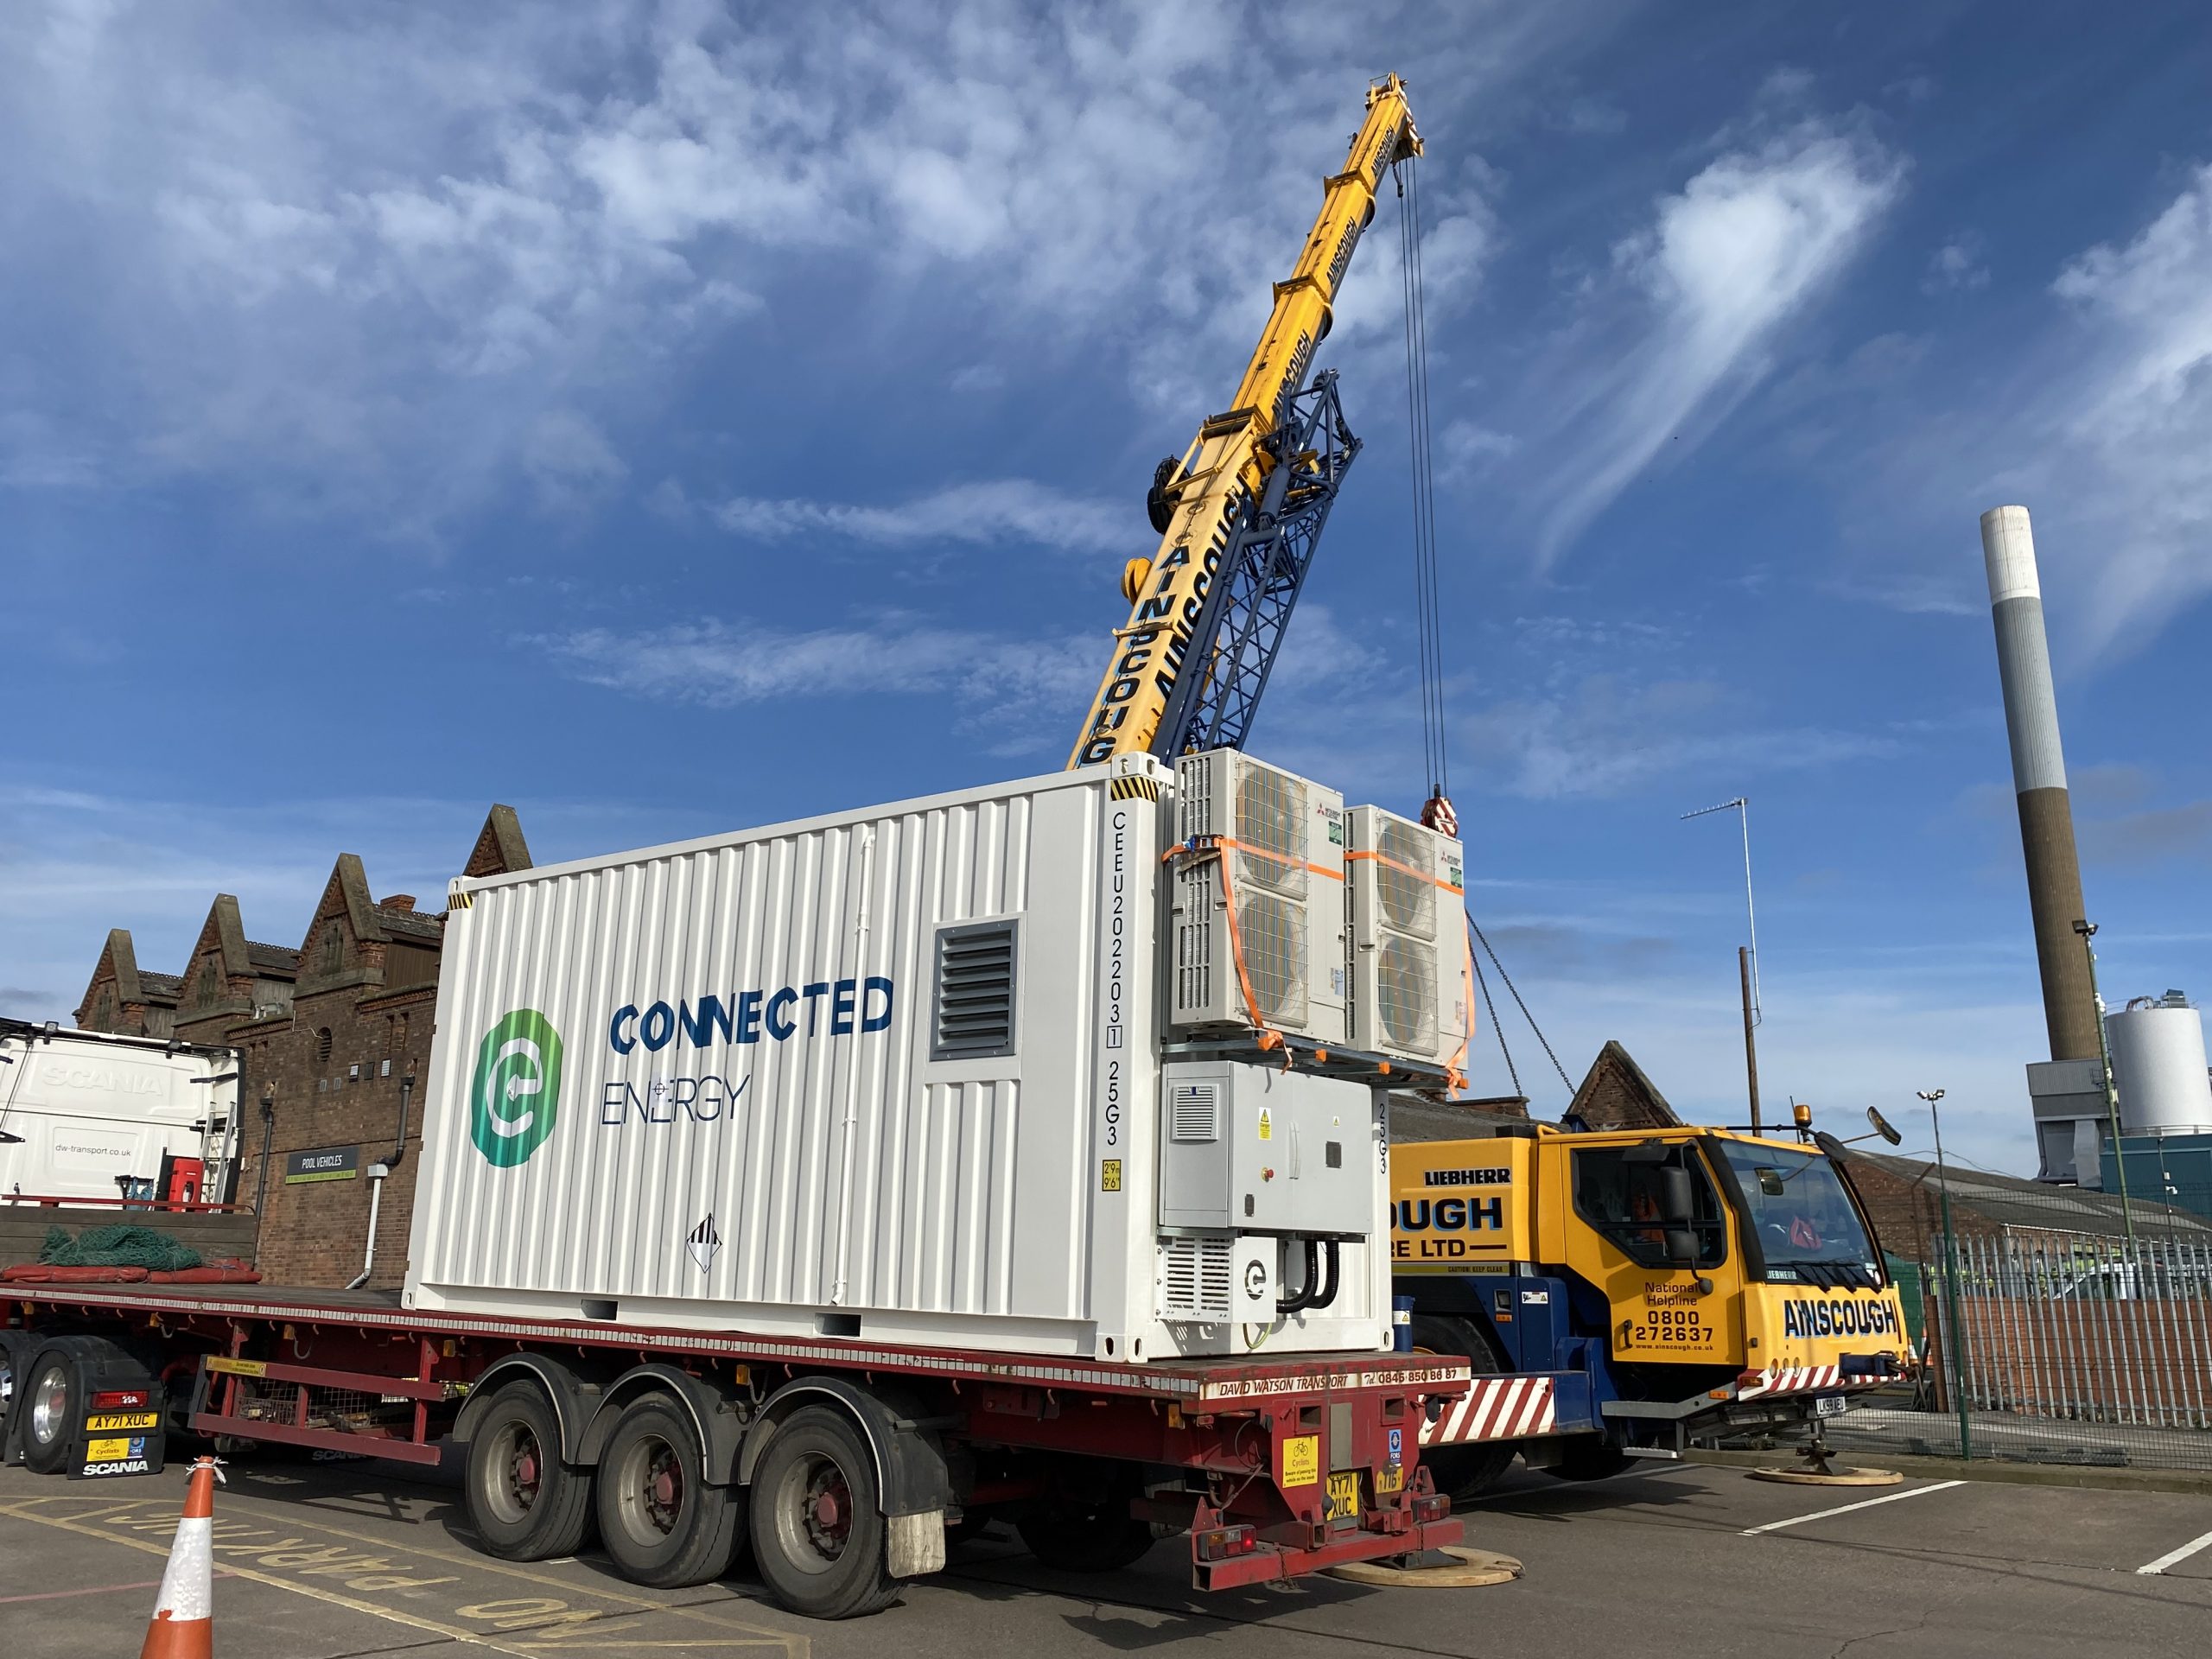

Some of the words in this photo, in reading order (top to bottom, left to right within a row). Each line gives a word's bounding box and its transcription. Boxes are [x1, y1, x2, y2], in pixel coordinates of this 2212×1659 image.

[1371, 124, 1395, 181] AINSCOUGH
[1326, 215, 1358, 291] AINSCOUGH
[610, 976, 893, 1056] CONNECTED
[43, 1066, 164, 1096] SCANIA
[601, 1074, 751, 1125] ENERGY
[1105, 1060, 1121, 1147] 25G3
[55, 1144, 131, 1157] dw-transport.co.uk
[302, 1158, 316, 1169] POOL
[316, 1154, 343, 1168] VEHICLES
[1424, 1168, 1511, 1186] LIEBHERR
[1390, 1197, 1503, 1231] UGH
[1421, 1239, 1466, 1257] LTD
[1644, 1282, 1699, 1294] National
[1647, 1294, 1697, 1308] Helpline
[1648, 1310, 1700, 1325] 0800
[1783, 1299, 1897, 1338] AINSCOUGH
[1636, 1326, 1713, 1342] 272637
[1219, 1382, 1250, 1396] DAVID
[1254, 1378, 1294, 1394] WATSON
[1296, 1375, 1349, 1390] TRANSPORT
[1408, 1370, 1427, 1382] 850
[1446, 1368, 1457, 1379] 87
[95, 1415, 123, 1428] AY71
[124, 1414, 150, 1427] XUC
[82, 1460, 149, 1476] SCANIA
[1292, 1459, 1310, 1468] Cyclists
[1331, 1474, 1352, 1496] AY71
[1332, 1497, 1351, 1518] XUC
